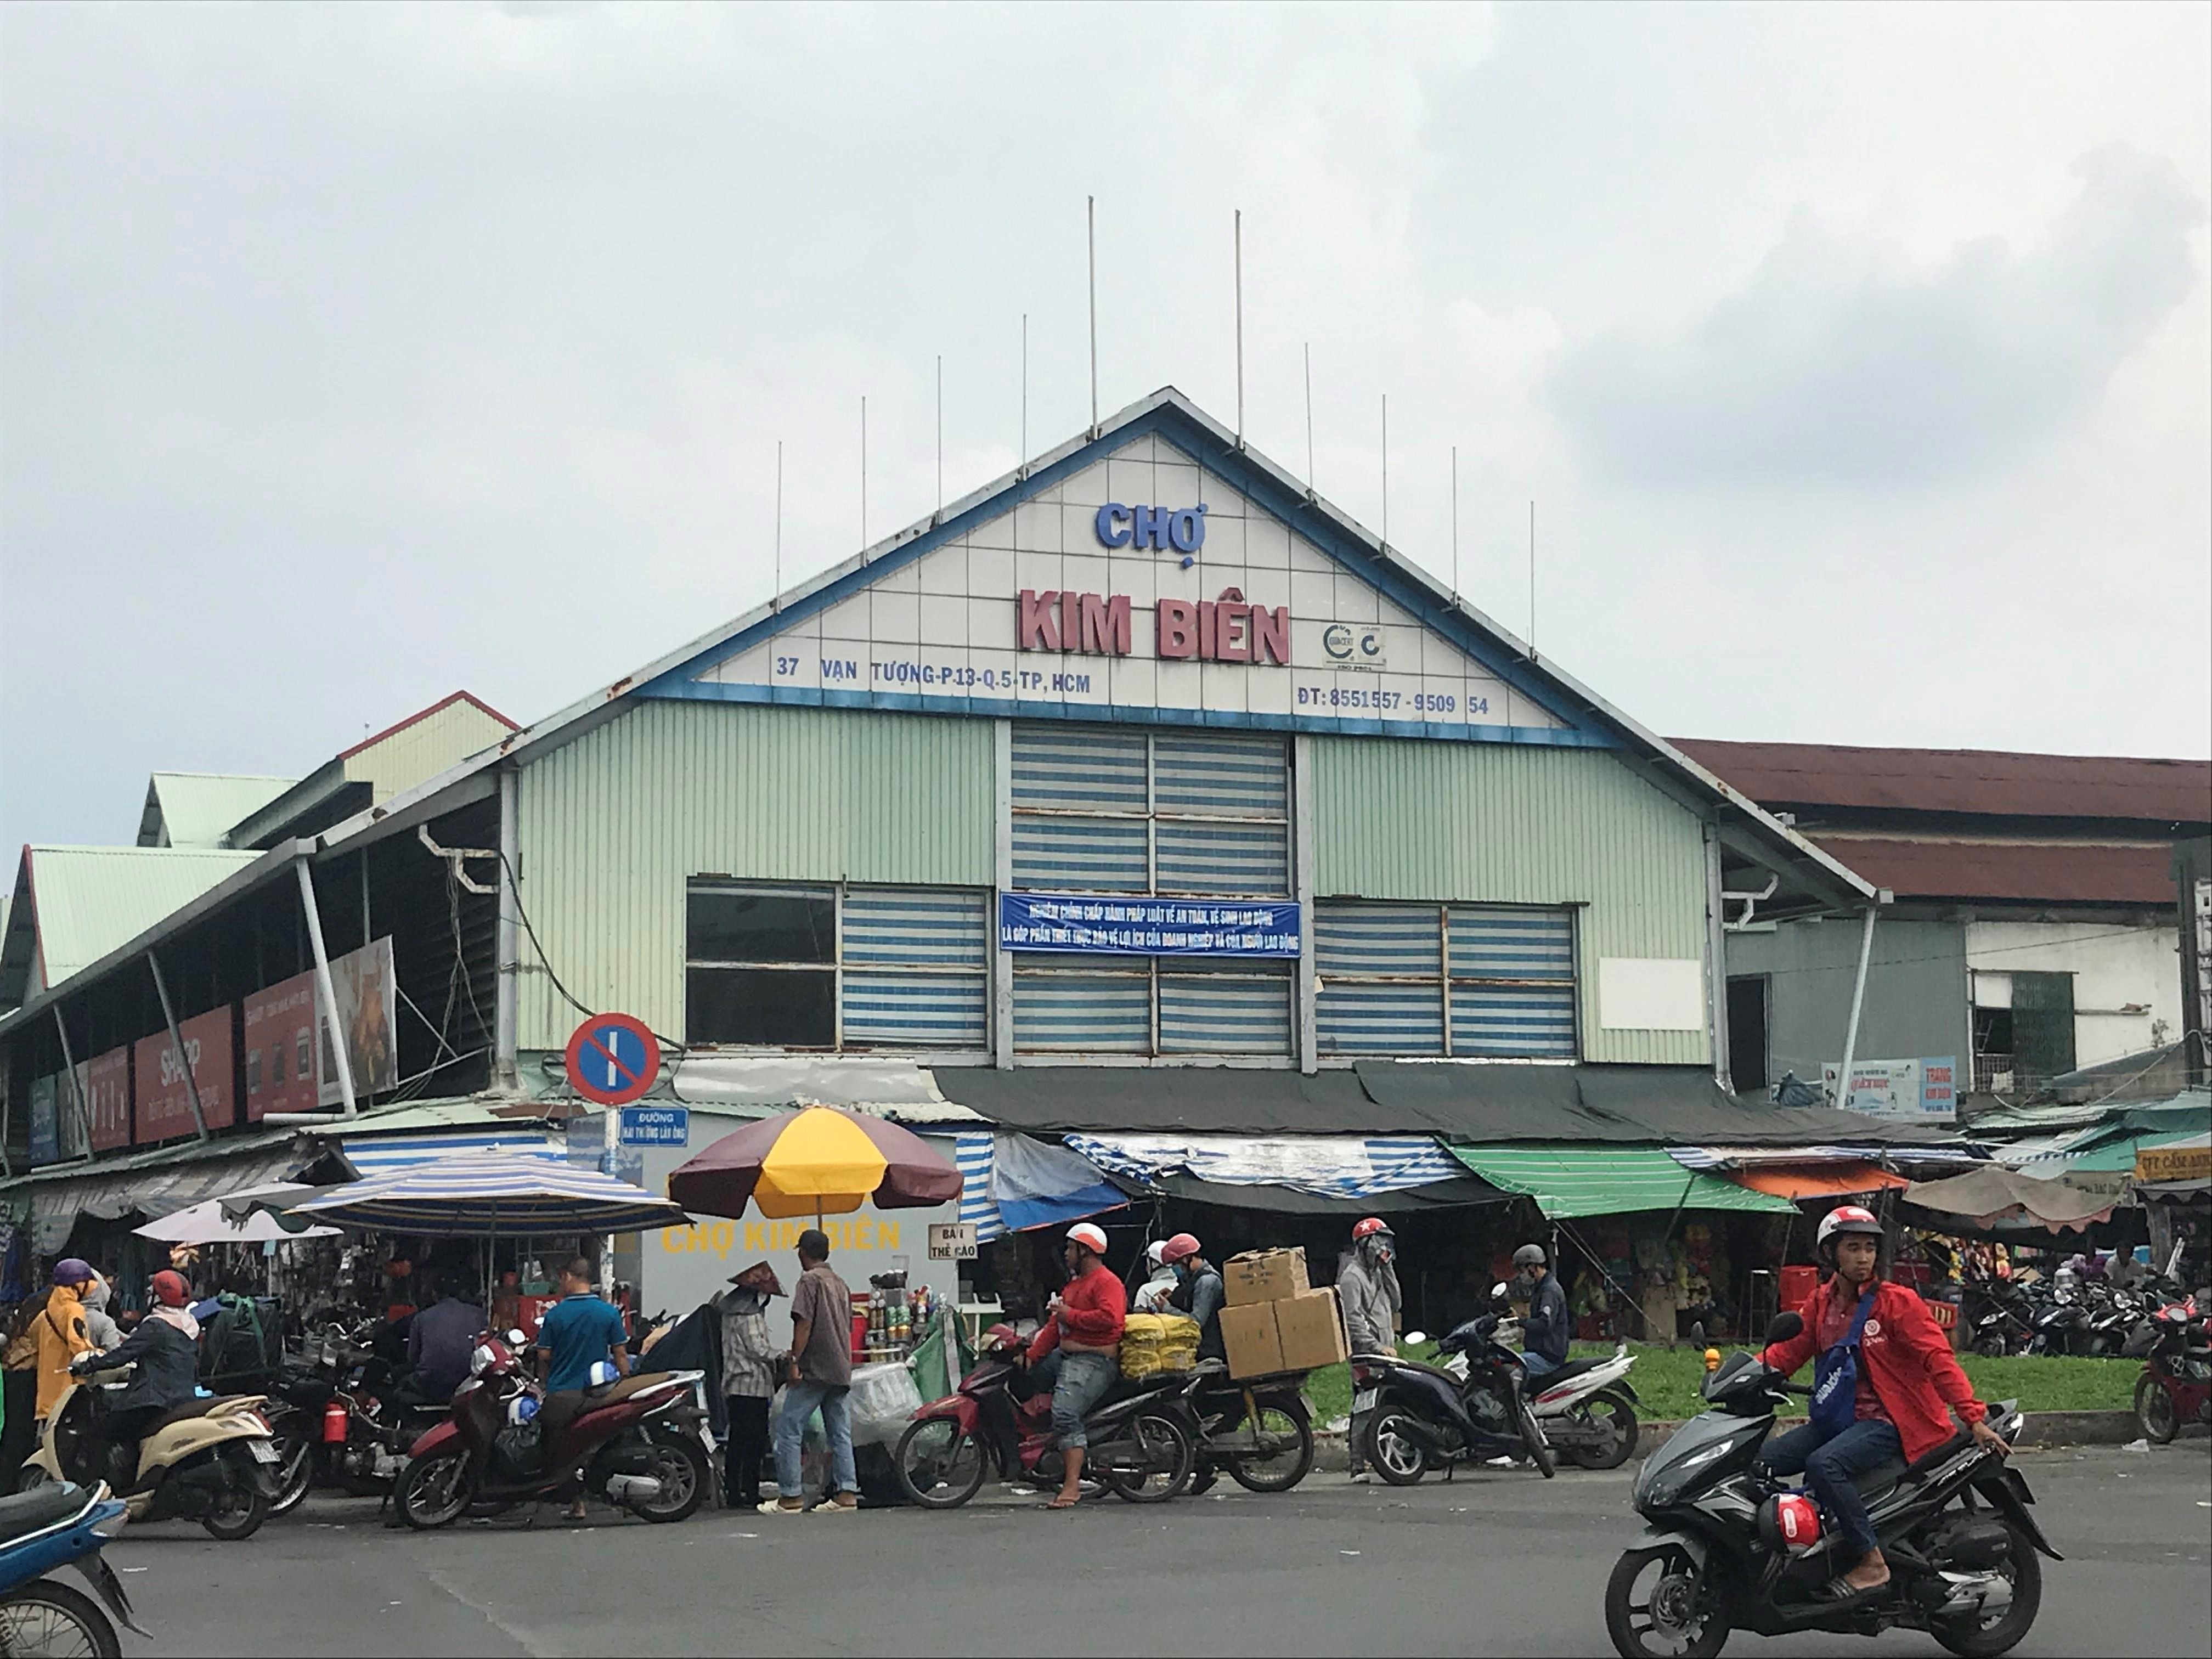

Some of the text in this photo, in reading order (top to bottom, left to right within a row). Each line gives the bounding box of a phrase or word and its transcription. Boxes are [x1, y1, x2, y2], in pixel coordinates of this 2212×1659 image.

[1097, 503, 1209, 569] CHỢ
[1018, 587, 1289, 664] KIM BIÊN
[776, 657, 799, 675] 37
[821, 660, 856, 682] VẠN
[1052, 673, 1090, 693] HCM
[1469, 696, 1488, 714] 54
[662, 1219, 735, 1261] CHỢ
[744, 1221, 810, 1251] KIM
